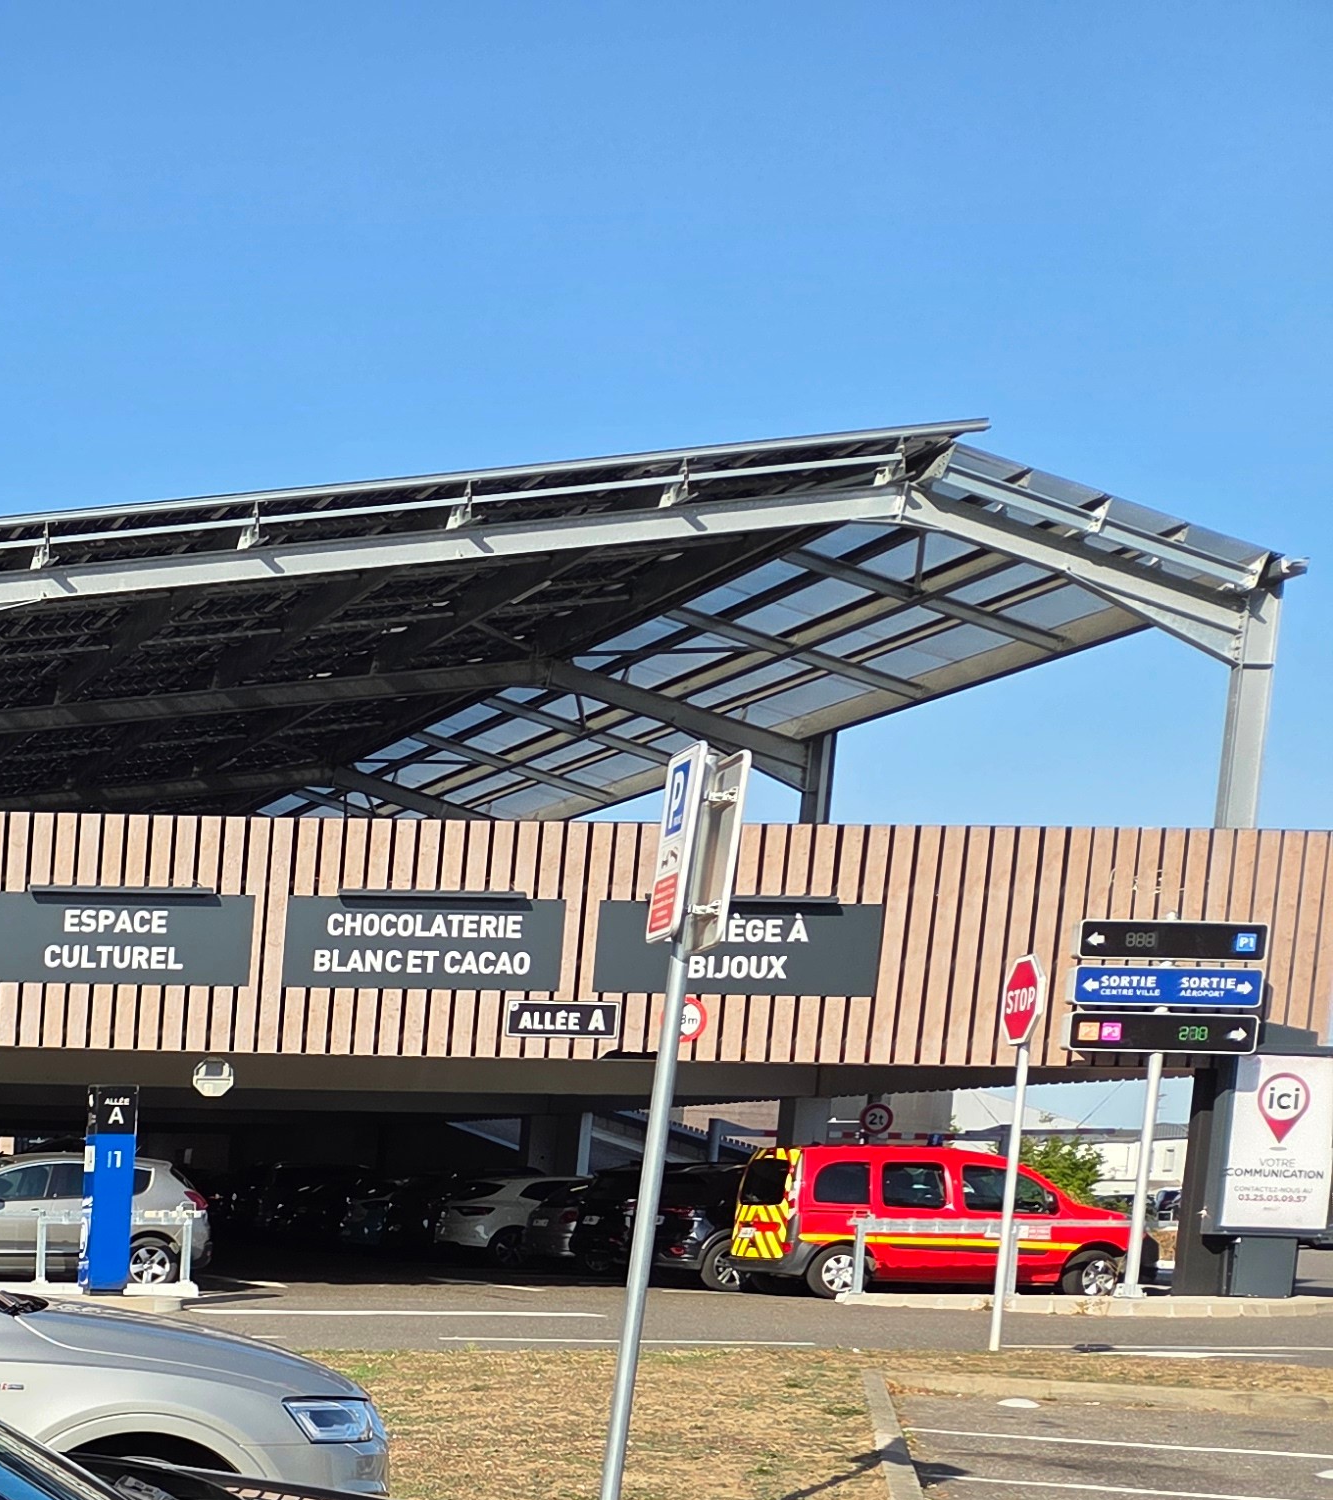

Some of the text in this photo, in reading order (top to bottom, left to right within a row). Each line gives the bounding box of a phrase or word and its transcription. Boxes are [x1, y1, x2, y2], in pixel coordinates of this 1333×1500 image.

[64, 909, 169, 934] ESPACE
[327, 913, 523, 939] CHOCOLATERIE
[787, 912, 809, 942] À
[44, 944, 184, 970] CULTUREL
[313, 948, 531, 975] BLANC ET CACAO
[687, 955, 788, 979] BIJOUX
[1100, 975, 1156, 987] SORTIE
[1181, 977, 1236, 989] SORTIE
[1006, 985, 1036, 1014] STOP
[1136, 989, 1160, 997] VILLE
[518, 1009, 605, 1031] ALLÉE A
[1268, 1087, 1300, 1110] ici
[107, 1107, 124, 1124] A
[1225, 1167, 1324, 1179] COMMUNICATION
[1259, 1158, 1296, 1168] VOTRE
